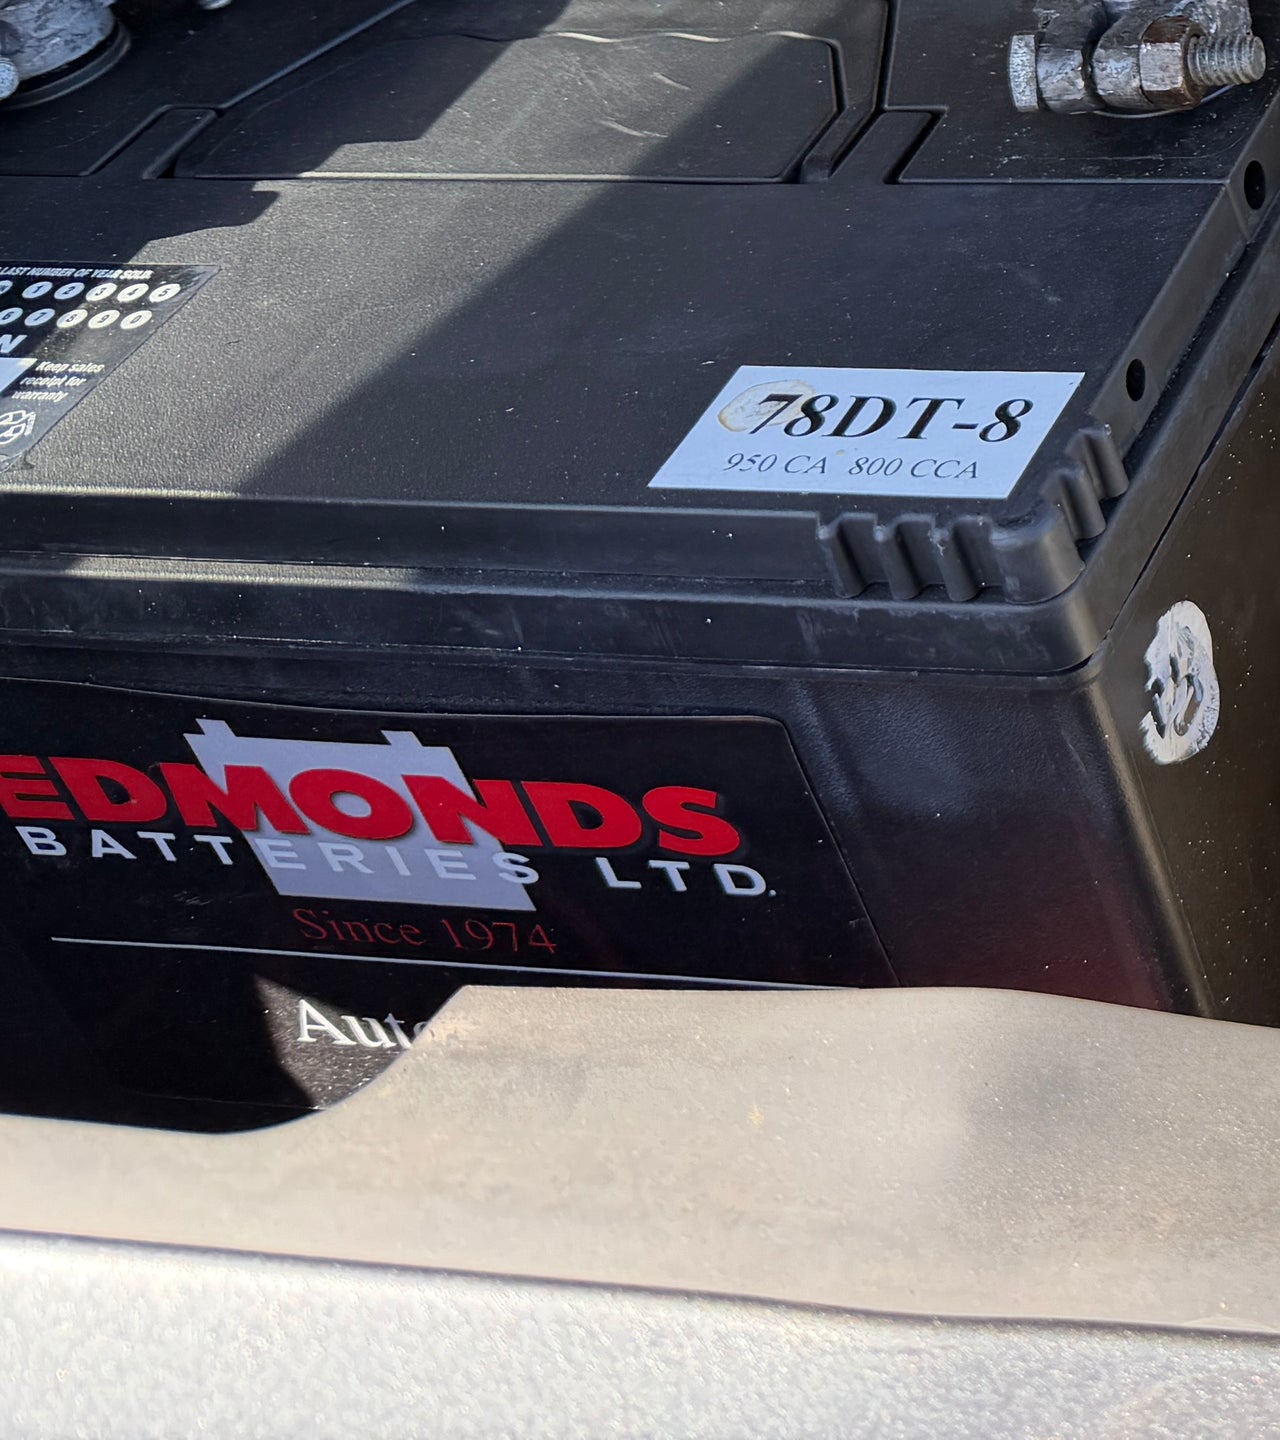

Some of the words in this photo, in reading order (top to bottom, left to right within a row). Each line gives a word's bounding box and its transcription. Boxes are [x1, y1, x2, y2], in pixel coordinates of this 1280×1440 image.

[19, 375, 67, 387] receipt
[65, 375, 87, 387] for
[35, 361, 68, 373] Keep
[68, 361, 105, 373] sales
[11, 390, 69, 403] warranty
[748, 392, 1035, 443] 78DT-8
[722, 452, 779, 472] 950
[784, 457, 828, 476] CA
[848, 456, 902, 478] 800
[910, 458, 980, 480] CCA
[0, 754, 741, 856] EDMONDS
[15, 825, 540, 885] BATTERIES
[600, 857, 778, 898] LTD.
[292, 908, 424, 947] Since
[441, 919, 557, 955] 1974
